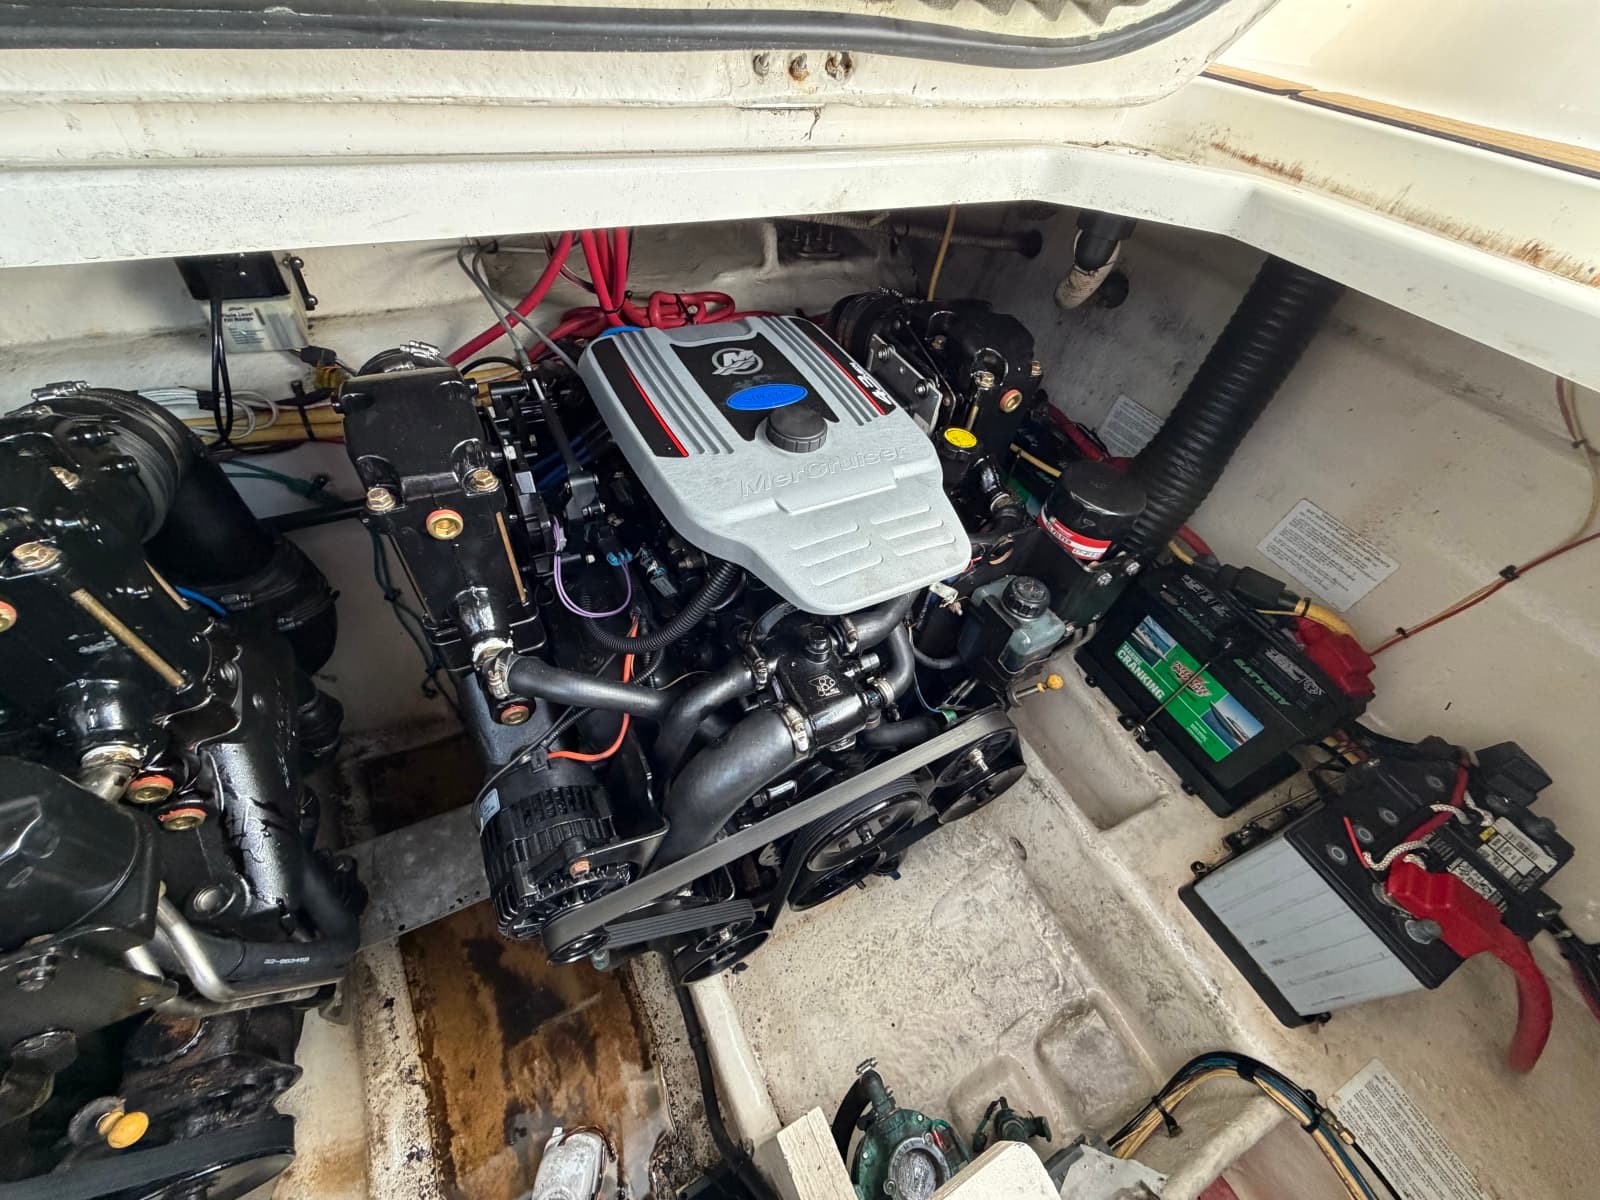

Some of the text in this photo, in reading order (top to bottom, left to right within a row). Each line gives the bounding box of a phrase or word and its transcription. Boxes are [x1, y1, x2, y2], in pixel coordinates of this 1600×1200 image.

[740, 446, 906, 498] MerCruiser
[1116, 650, 1166, 701] CRANKING
[1233, 658, 1291, 706] BATTERY
